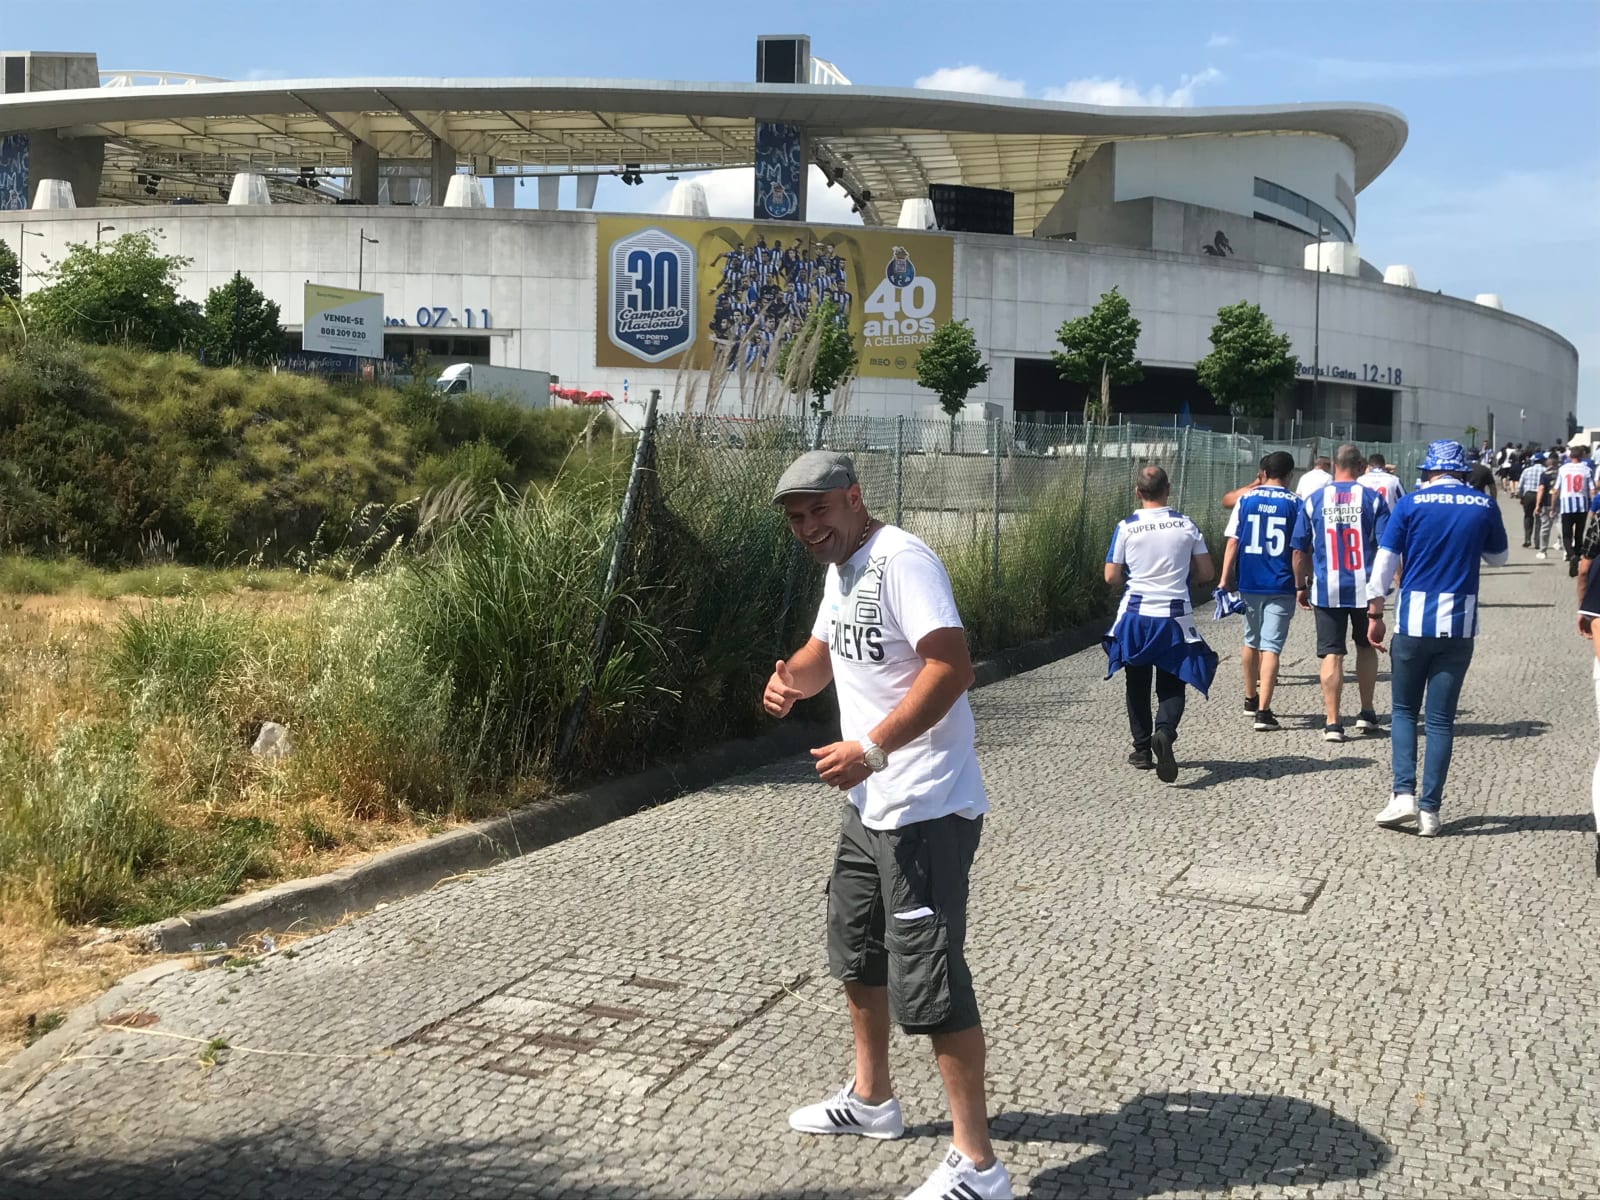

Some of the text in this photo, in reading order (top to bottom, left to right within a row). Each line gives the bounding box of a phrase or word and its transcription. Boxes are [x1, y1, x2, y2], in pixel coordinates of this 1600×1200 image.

[627, 250, 678, 311] 30
[863, 275, 936, 320] 40
[323, 313, 365, 326] VENDE-SE
[384, 316, 406, 327] tes
[620, 318, 682, 332] Nacional
[863, 317, 935, 337] anos
[320, 327, 367, 339] 808 209 020
[864, 338, 872, 347] A
[1332, 366, 1357, 380] Gates
[1362, 363, 1402, 385] 12-18
[1271, 490, 1297, 503] BOCK
[1413, 493, 1490, 508] SUPER BOCK
[1328, 515, 1358, 524] SANTO
[1127, 520, 1186, 535] SUPER BOCK
[1244, 514, 1287, 558] 15
[1326, 527, 1363, 571] 18
